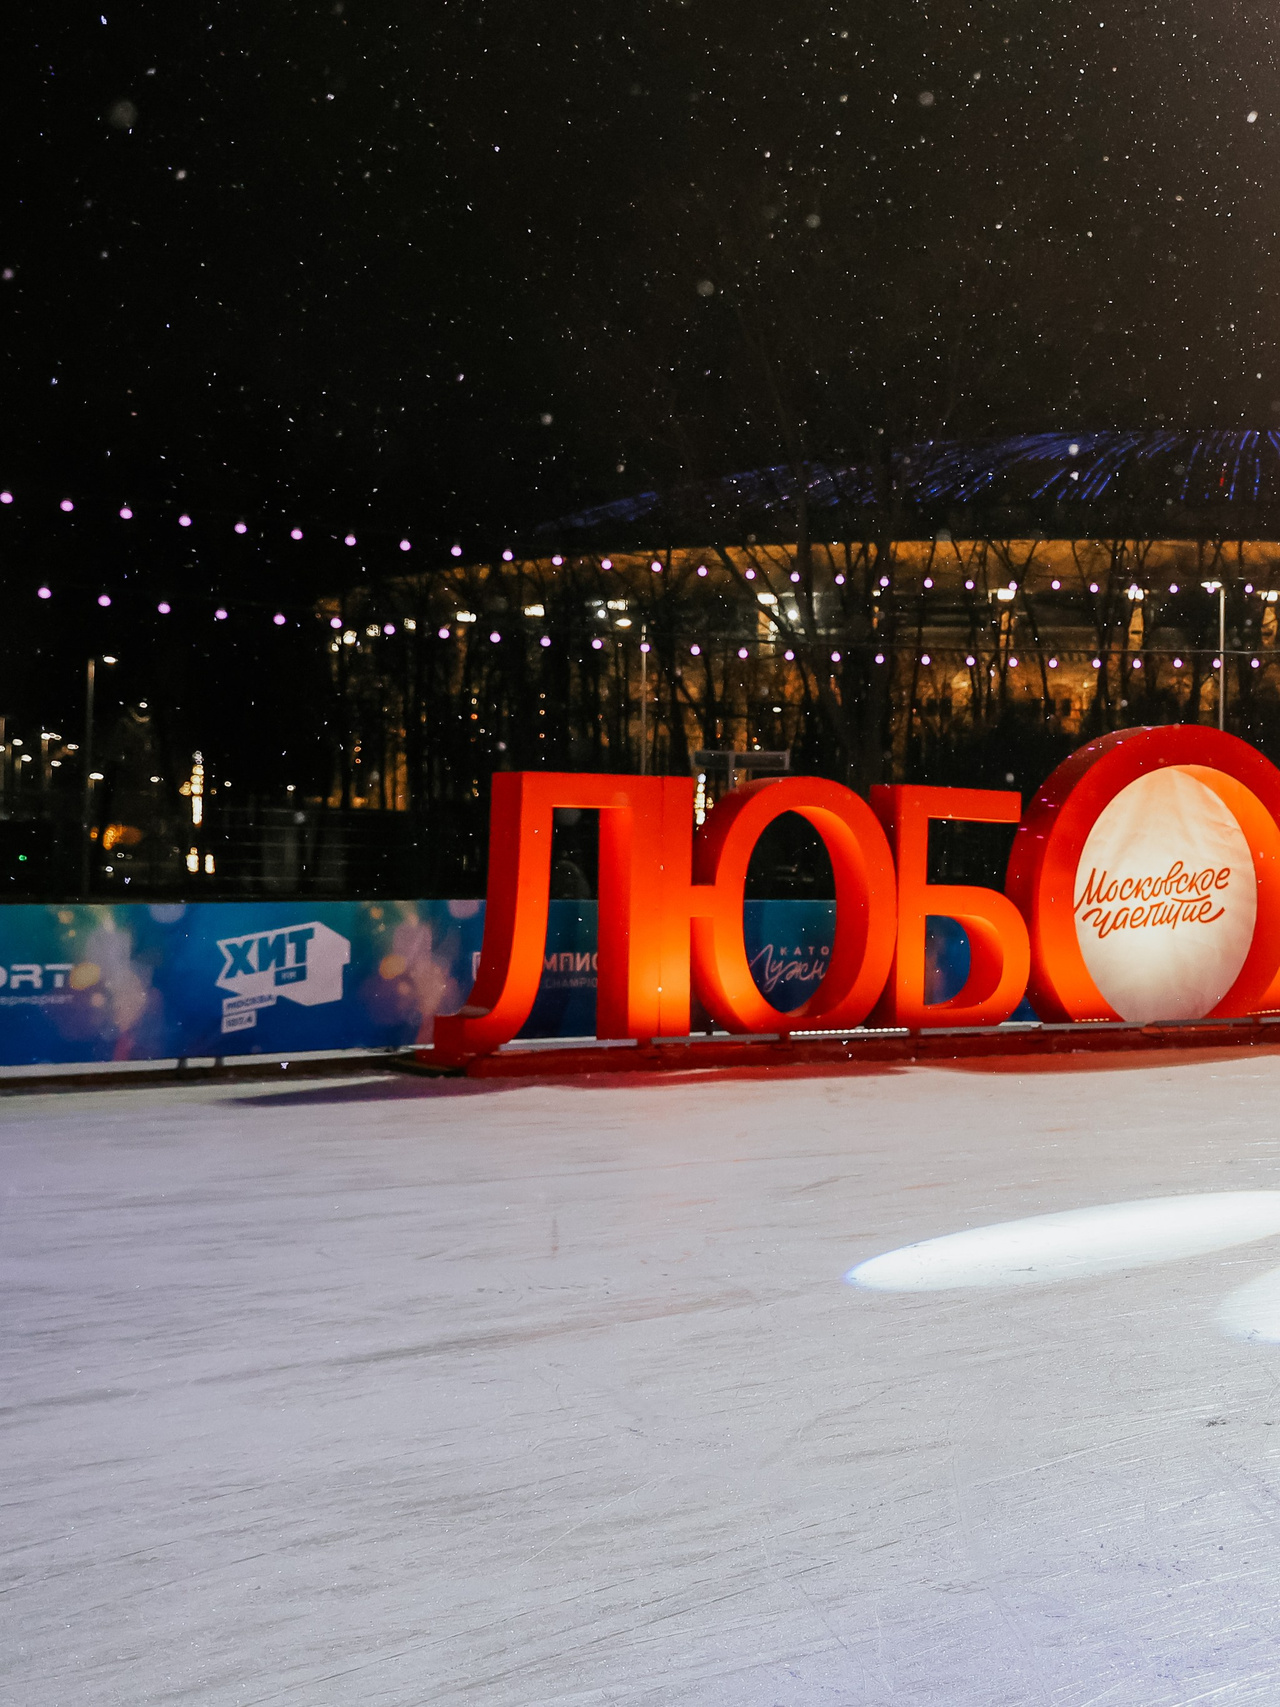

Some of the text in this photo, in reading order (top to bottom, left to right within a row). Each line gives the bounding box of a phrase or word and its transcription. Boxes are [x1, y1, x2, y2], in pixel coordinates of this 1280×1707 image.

[1074, 861, 1231, 914] Московское
[1083, 897, 1225, 938] чаепитие
[225, 928, 315, 980] ХИТ
[780, 946, 830, 956] КАТО
